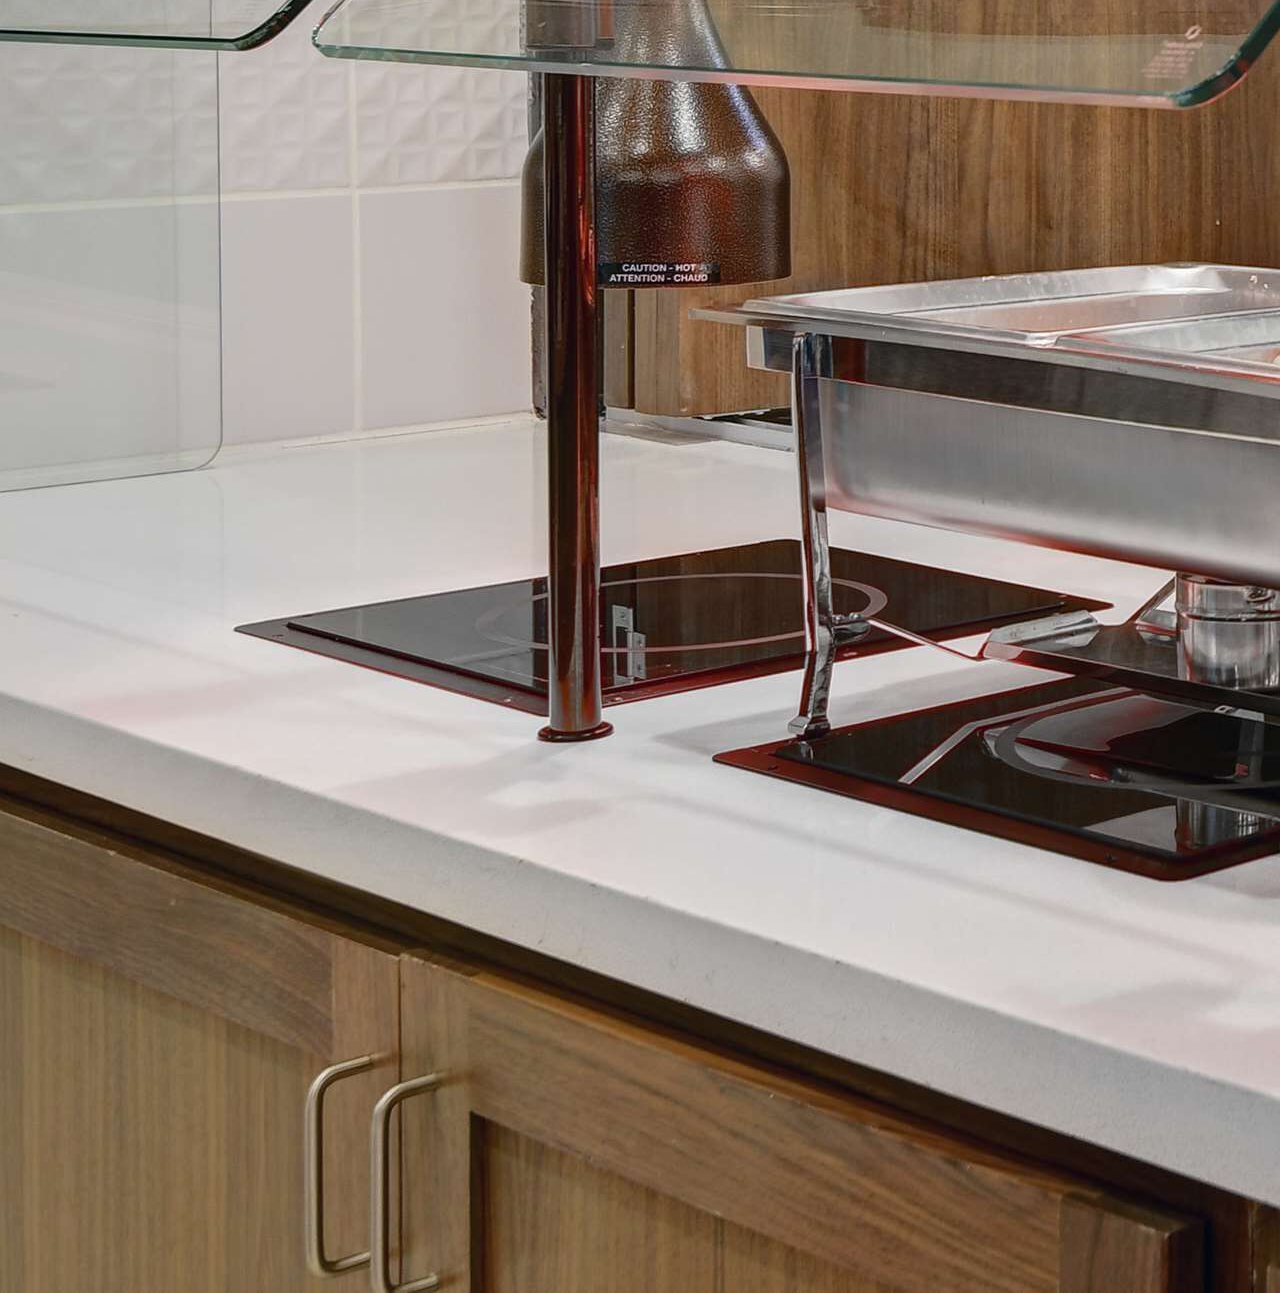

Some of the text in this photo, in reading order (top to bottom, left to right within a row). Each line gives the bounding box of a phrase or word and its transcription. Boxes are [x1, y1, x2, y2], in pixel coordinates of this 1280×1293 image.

[622, 263, 667, 272] CAUTION
[675, 263, 697, 272] HOT
[609, 274, 665, 282] ATTENTION
[673, 273, 708, 282] CHAUD
